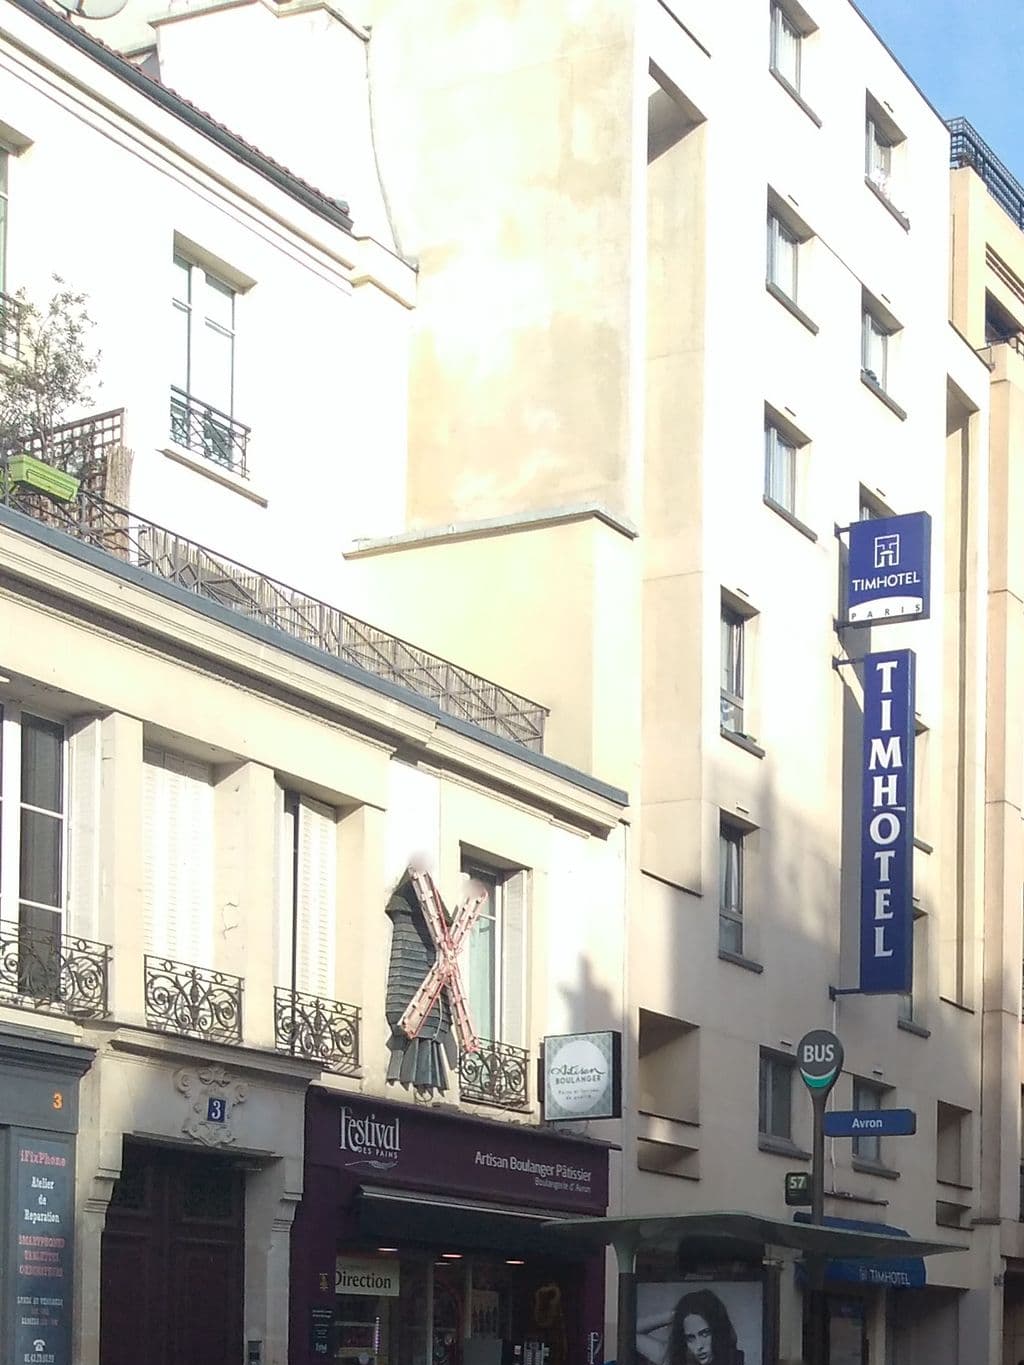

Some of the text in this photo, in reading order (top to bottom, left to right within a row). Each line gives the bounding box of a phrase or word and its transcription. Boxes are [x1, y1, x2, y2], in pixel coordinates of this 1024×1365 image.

[852, 573, 920, 593] TIMHOTEL
[851, 603, 921, 620] PARIS
[868, 660, 904, 958] TIMHOTEL
[803, 1043, 834, 1063] BUS
[555, 1074, 603, 1085] BOULANGER
[53, 1092, 63, 1110] 3
[211, 1099, 222, 1120] 3
[340, 1105, 401, 1152] Festival
[851, 1117, 883, 1129] Avron
[358, 1147, 398, 1160] DES PAINS
[475, 1151, 592, 1182] Artisan Boulanger Pâtissier
[31, 1176, 54, 1189] Atelier
[789, 1175, 805, 1189] 57
[38, 1194, 47, 1205] de
[24, 1209, 60, 1224] Reparation
[869, 1268, 911, 1286] TIMHOTEL
